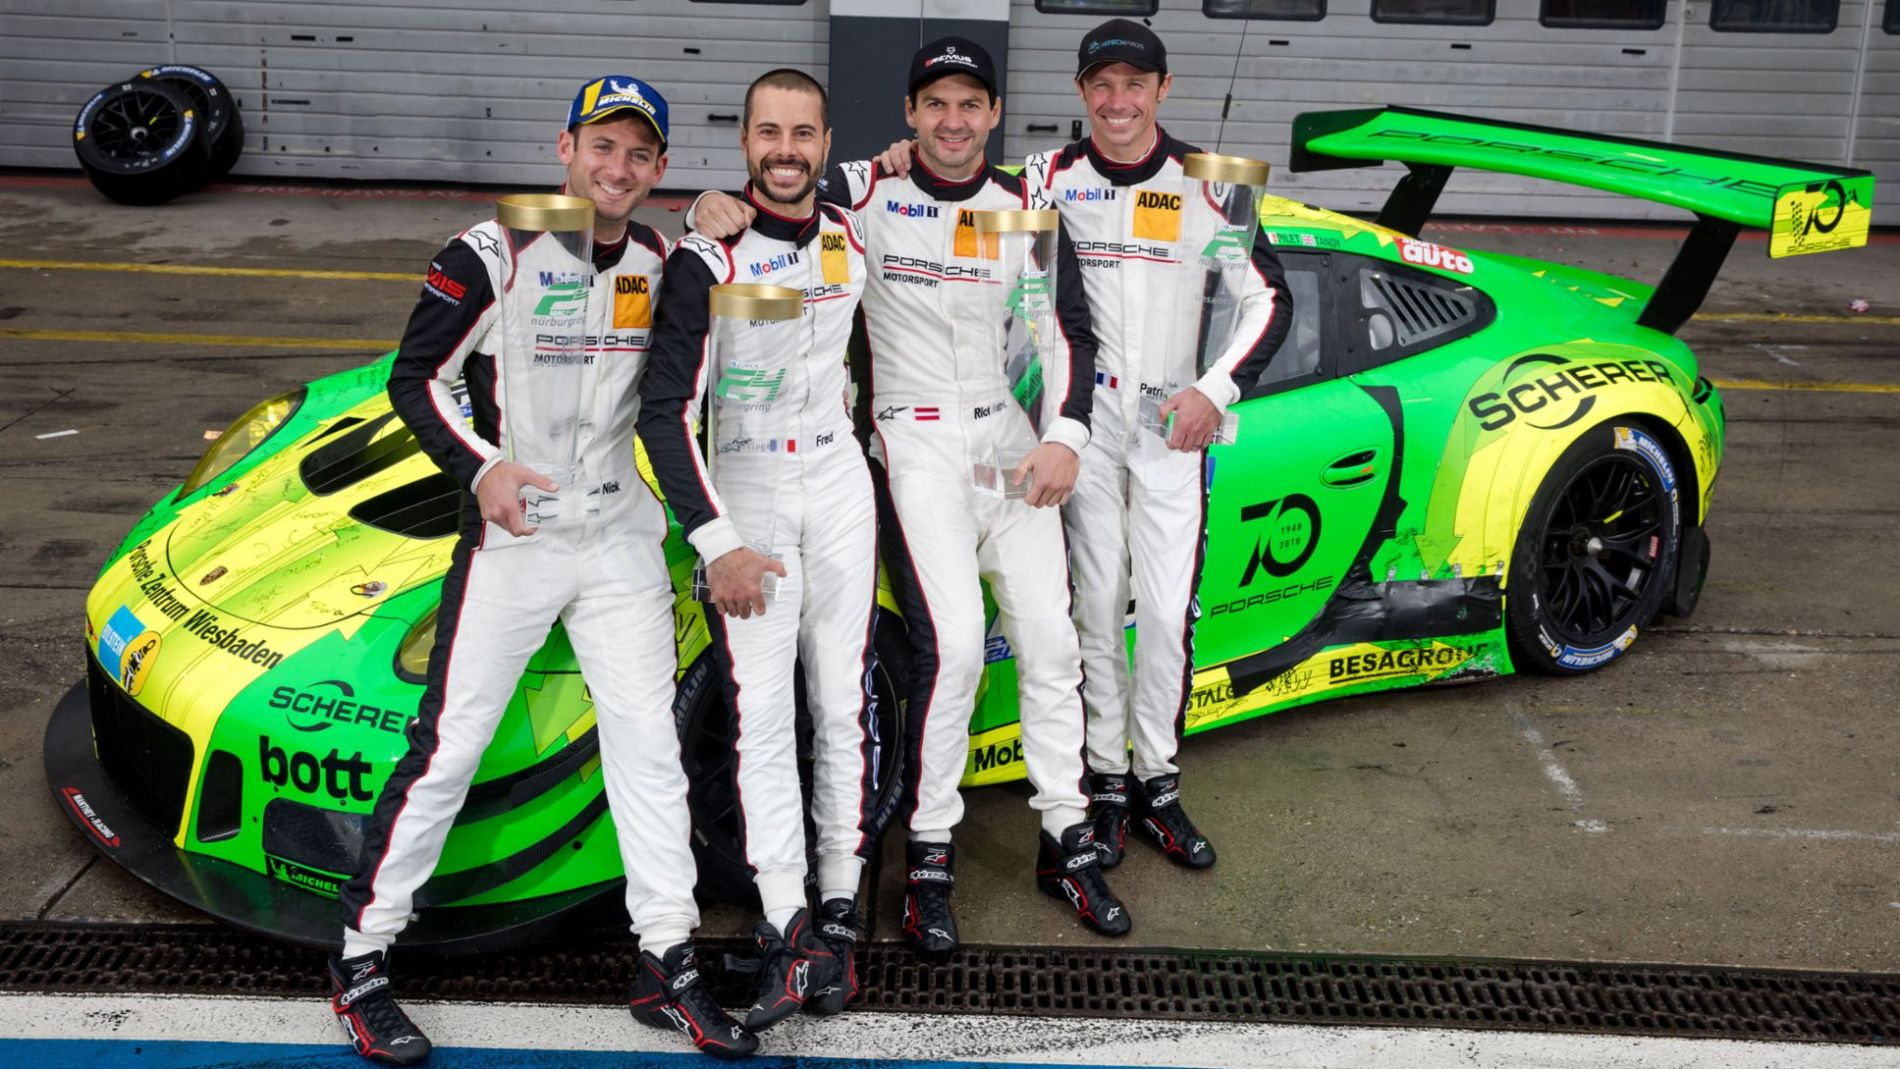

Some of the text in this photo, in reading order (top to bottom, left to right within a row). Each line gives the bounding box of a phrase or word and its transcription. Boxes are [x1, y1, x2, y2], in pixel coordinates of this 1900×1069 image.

[598, 95, 656, 116] MICHELIN
[1367, 128, 1781, 200] PORSCHE
[1065, 188, 1102, 202] Mobil
[1137, 191, 1181, 211] ADAC
[887, 200, 924, 218] Mobil
[821, 234, 846, 252] ADAC
[750, 257, 787, 277] Mobil
[884, 254, 991, 278] PORSCHE
[1078, 257, 1121, 269] TORSPORT
[1403, 243, 1474, 274] auto
[615, 276, 648, 294] ADAC
[883, 271, 938, 288] MOTORSPORT
[536, 333, 645, 347] PORSCHE
[1468, 359, 1677, 432] SCHERER
[816, 431, 834, 447] Fred
[1637, 437, 1675, 485] MICHELIN
[602, 481, 621, 496] Nick
[1238, 493, 1322, 588] 70
[129, 538, 285, 671] Porsche Zentrum Wiesbaden
[1209, 575, 1335, 619] PORSCHE
[1562, 650, 1617, 667] MICHELIN
[259, 735, 374, 802] bott
